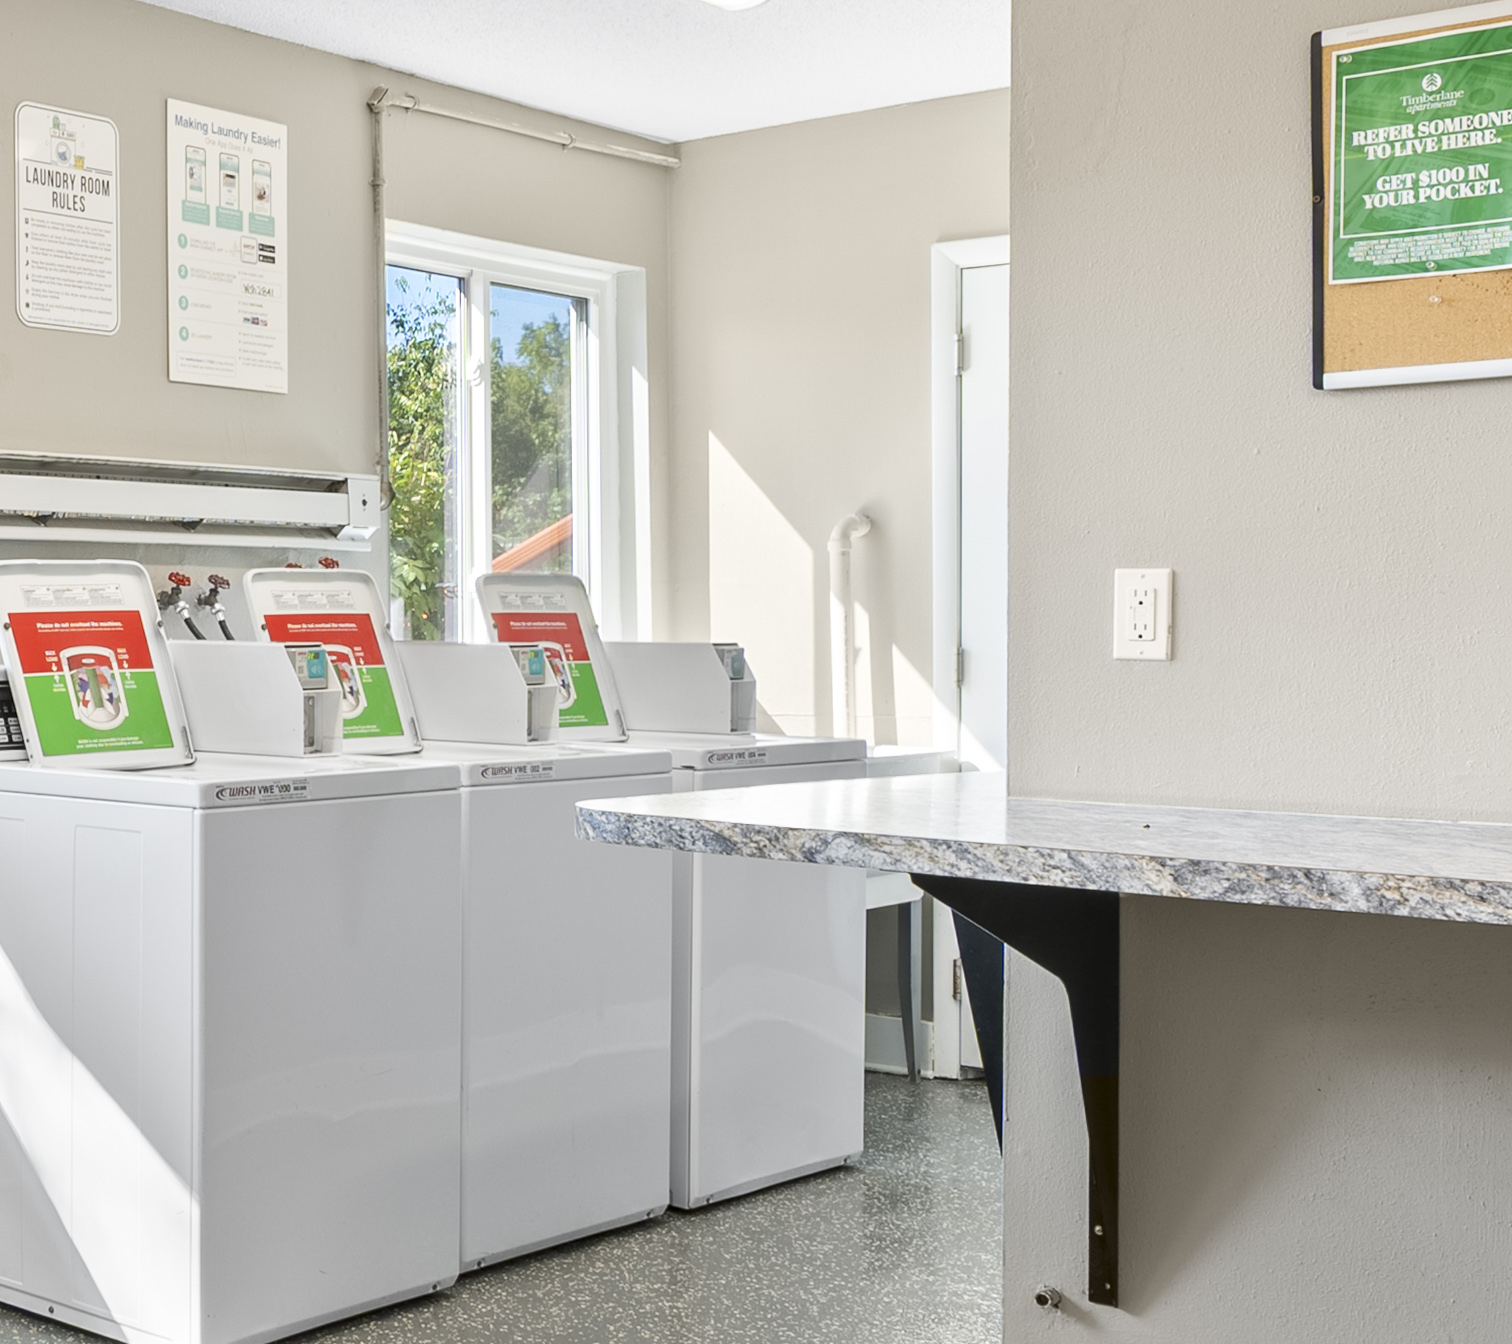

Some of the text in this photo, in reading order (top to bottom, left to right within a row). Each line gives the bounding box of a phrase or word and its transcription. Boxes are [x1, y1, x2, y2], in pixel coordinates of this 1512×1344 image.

[1400, 89, 1464, 107] Timberlane
[1406, 100, 1457, 114] apartments
[175, 115, 281, 149] Making Laundry Easier!
[1351, 124, 1414, 146] REFER
[1365, 128, 1502, 160] TO LIVE HERE.
[26, 166, 110, 196] LAUNDRY ROOM
[1376, 163, 1489, 192] GET $100 IN
[52, 192, 85, 212] RULES
[1362, 179, 1503, 210] YOUR POCKET.
[229, 786, 256, 796] WASH
[258, 785, 274, 794] VWE
